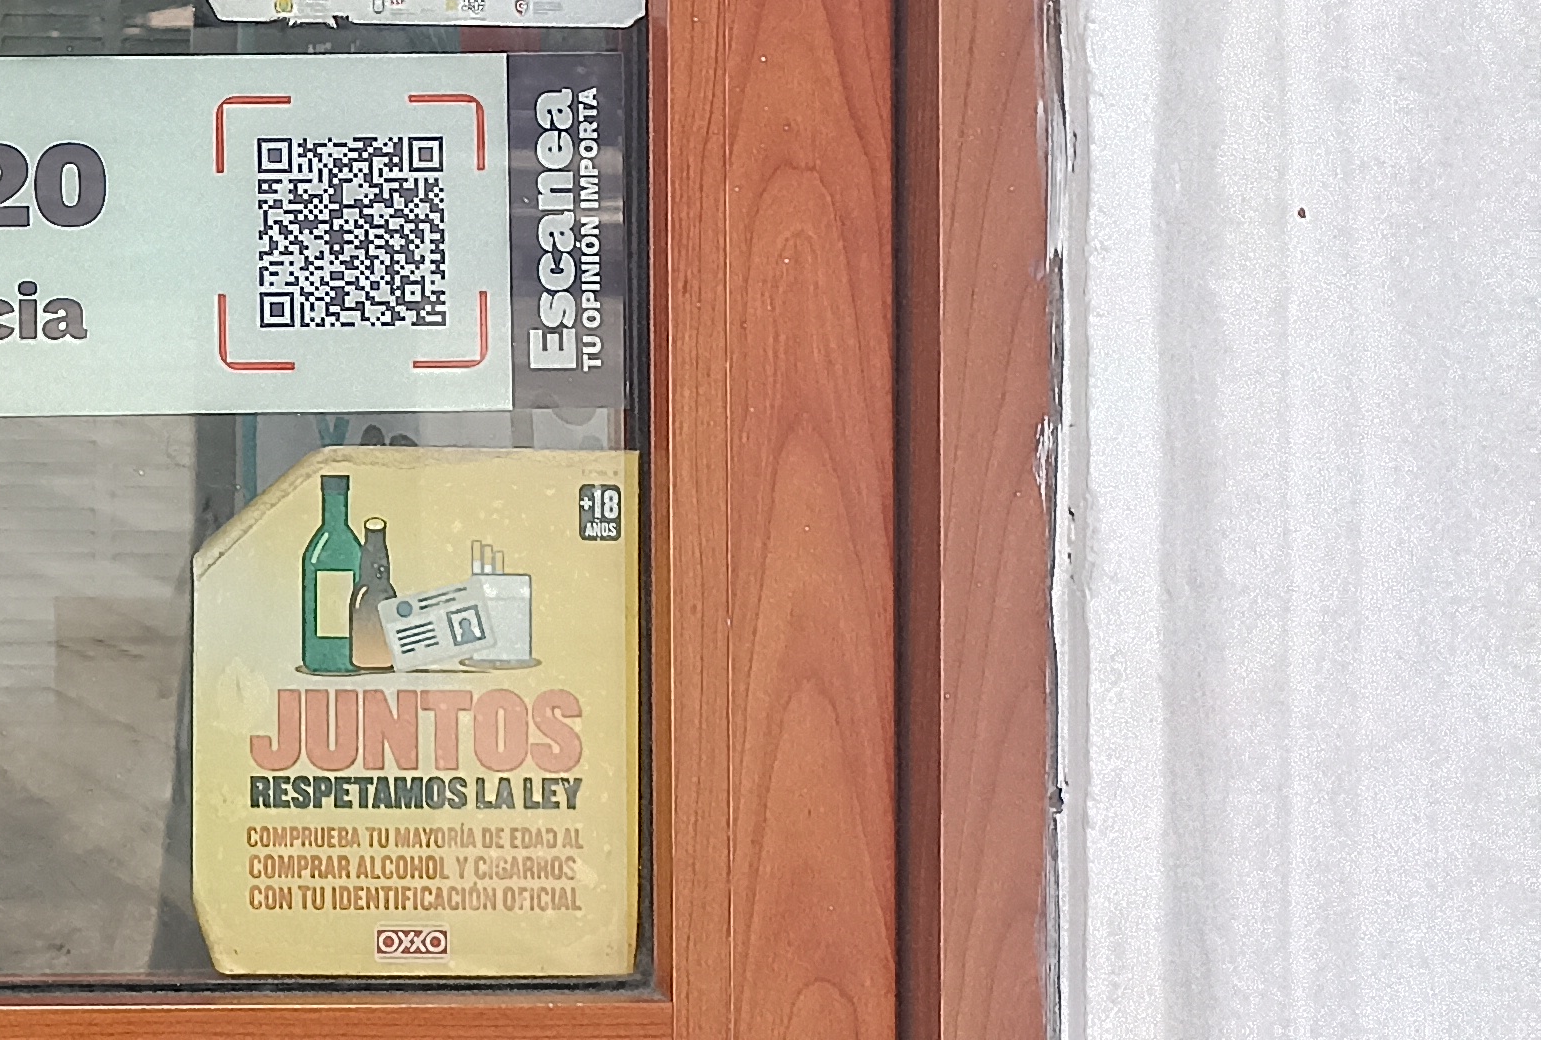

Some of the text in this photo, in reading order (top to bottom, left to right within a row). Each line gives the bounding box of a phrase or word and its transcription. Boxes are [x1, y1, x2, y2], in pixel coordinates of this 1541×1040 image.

[529, 87, 577, 369] Escanea
[576, 87, 602, 372] TU OPINIÓN IMPORTA
[580, 489, 619, 519] +18
[584, 519, 617, 537] AÑOS
[249, 688, 583, 774] JUNTOS
[249, 775, 583, 810] RESPETAMOS LA LEY
[246, 822, 584, 850] COMPRUEBA TU MAYORÍA DE EDAD AL
[248, 854, 577, 881] COMPRAR ALCOHOL Y CIGARROS
[248, 881, 583, 911] CON TU IDENTIFICACIÓN OFICIAL
[378, 929, 448, 955] OXXO
